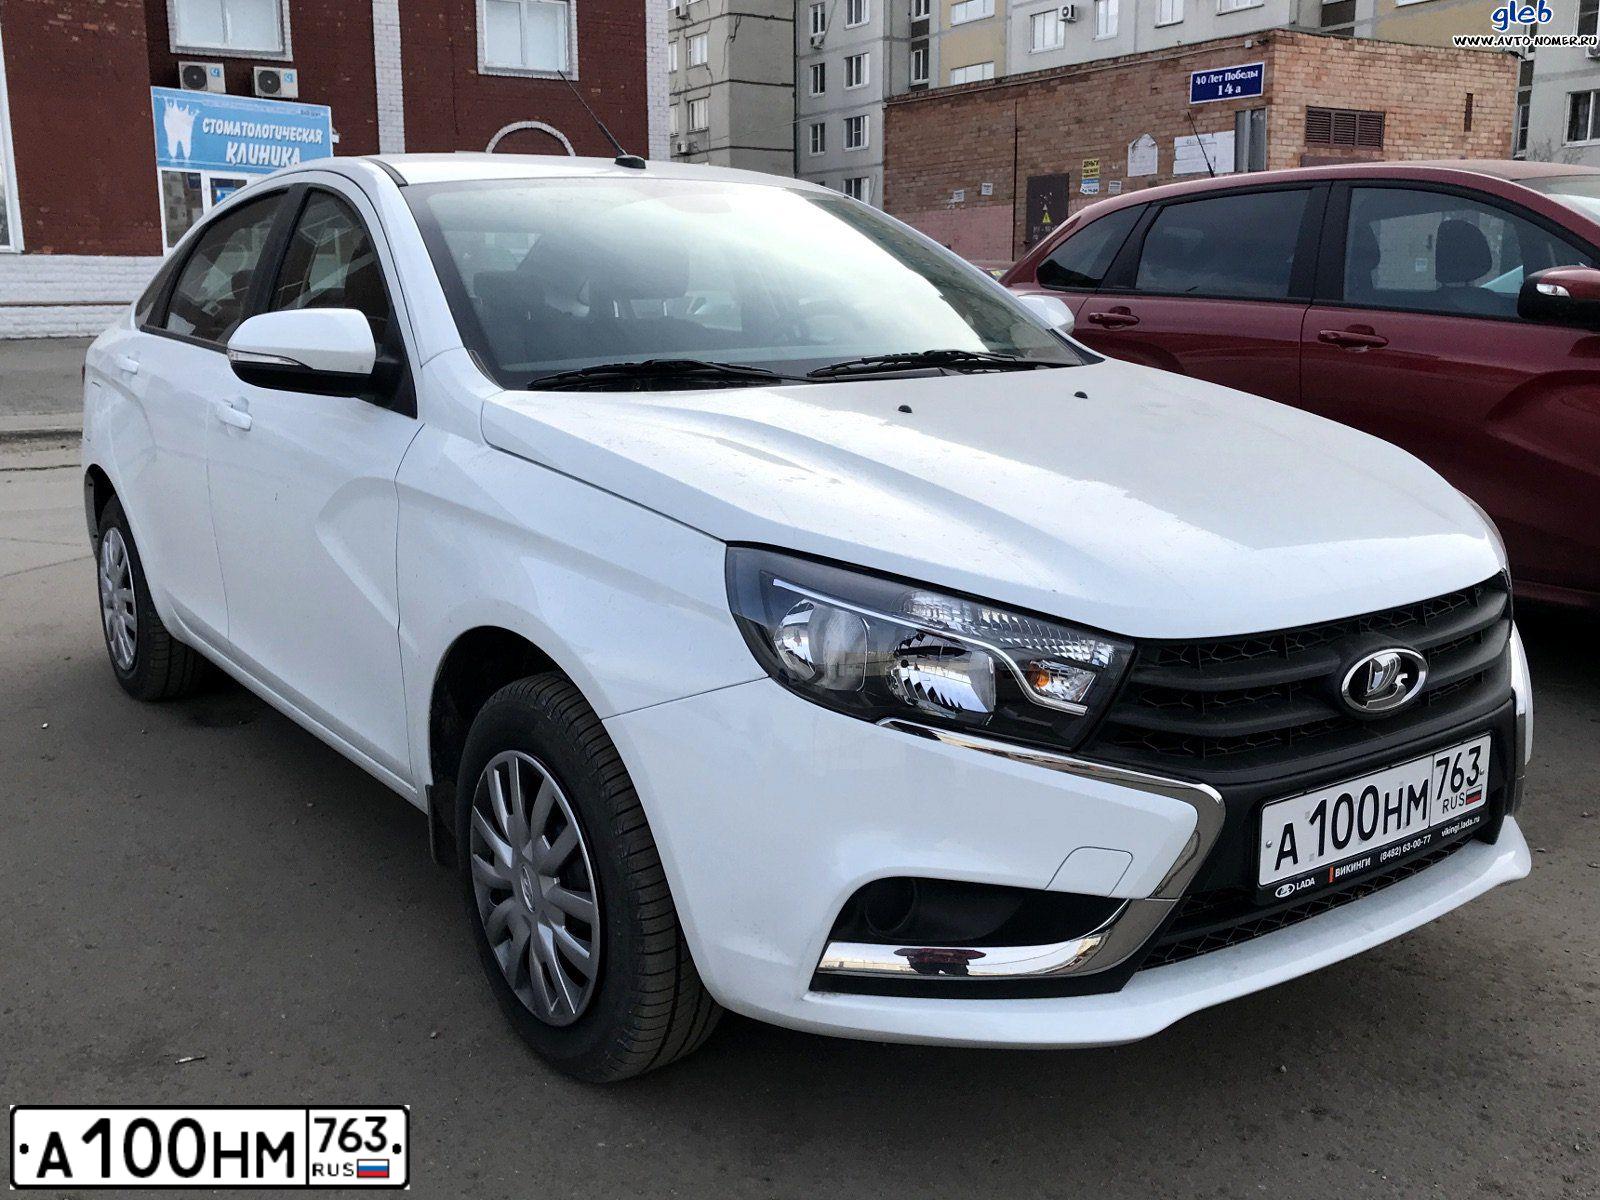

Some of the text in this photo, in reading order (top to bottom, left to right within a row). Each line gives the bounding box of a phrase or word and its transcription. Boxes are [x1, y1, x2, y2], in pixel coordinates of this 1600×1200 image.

[1208, 74, 1224, 84] Лет
[1224, 69, 1259, 82] Победы
[1218, 83, 1233, 96] 14
[202, 117, 324, 144] СТОМАТОЛОГИЧЕСКАЯ
[225, 141, 301, 167] КЛИНИКА
[1435, 745, 1482, 800] 763
[1442, 792, 1465, 814] RUS
[1334, 857, 1371, 878] ВИКИНГИ
[1296, 878, 1316, 891] LADA
